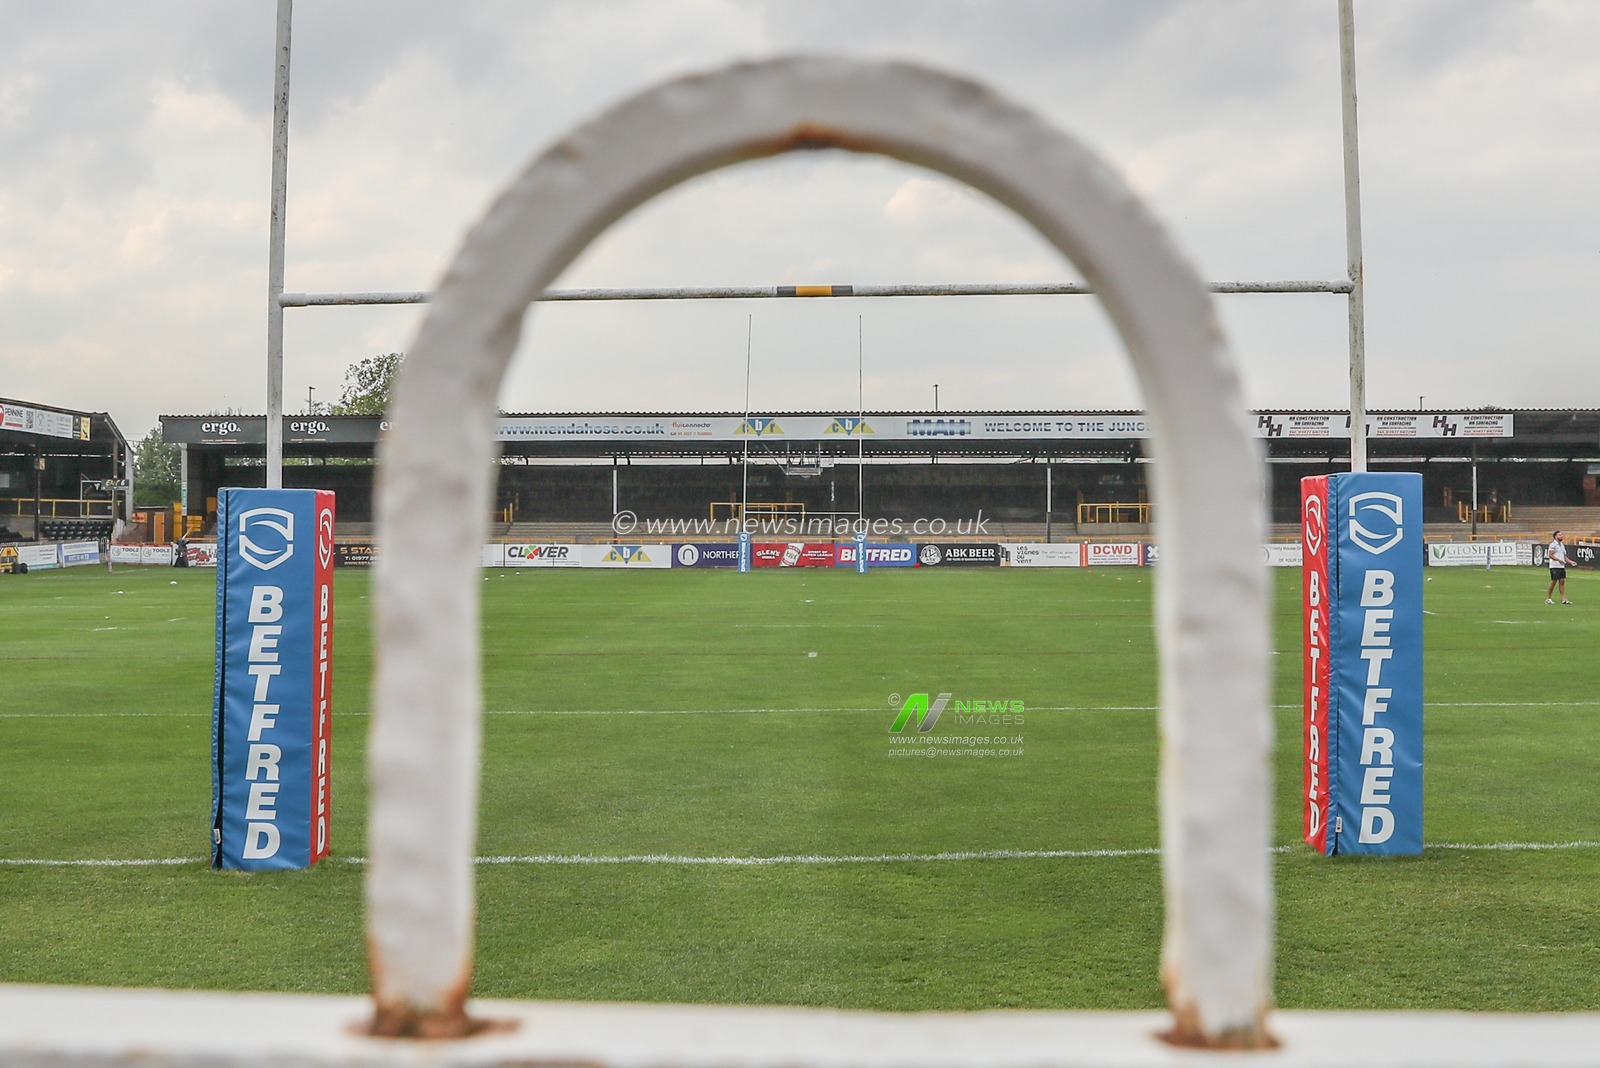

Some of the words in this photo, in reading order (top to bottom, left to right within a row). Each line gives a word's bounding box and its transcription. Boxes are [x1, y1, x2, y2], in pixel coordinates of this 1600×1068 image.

[984, 422, 1052, 432] WELCOME
[1055, 422, 1074, 432] TO
[1077, 422, 1105, 432] THE
[1108, 422, 1147, 432] JUNG
[702, 550, 740, 559] NORTHER
[945, 548, 968, 558] ABK
[969, 548, 996, 558] BEER
[1093, 545, 1133, 555] DCWD
[1447, 545, 1513, 555] GEOSHELD
[1308, 570, 1320, 838] BETFRED
[1358, 569, 1395, 844] BETFRED
[242, 585, 284, 860] BETFRED
[316, 584, 328, 856] BETFRED
